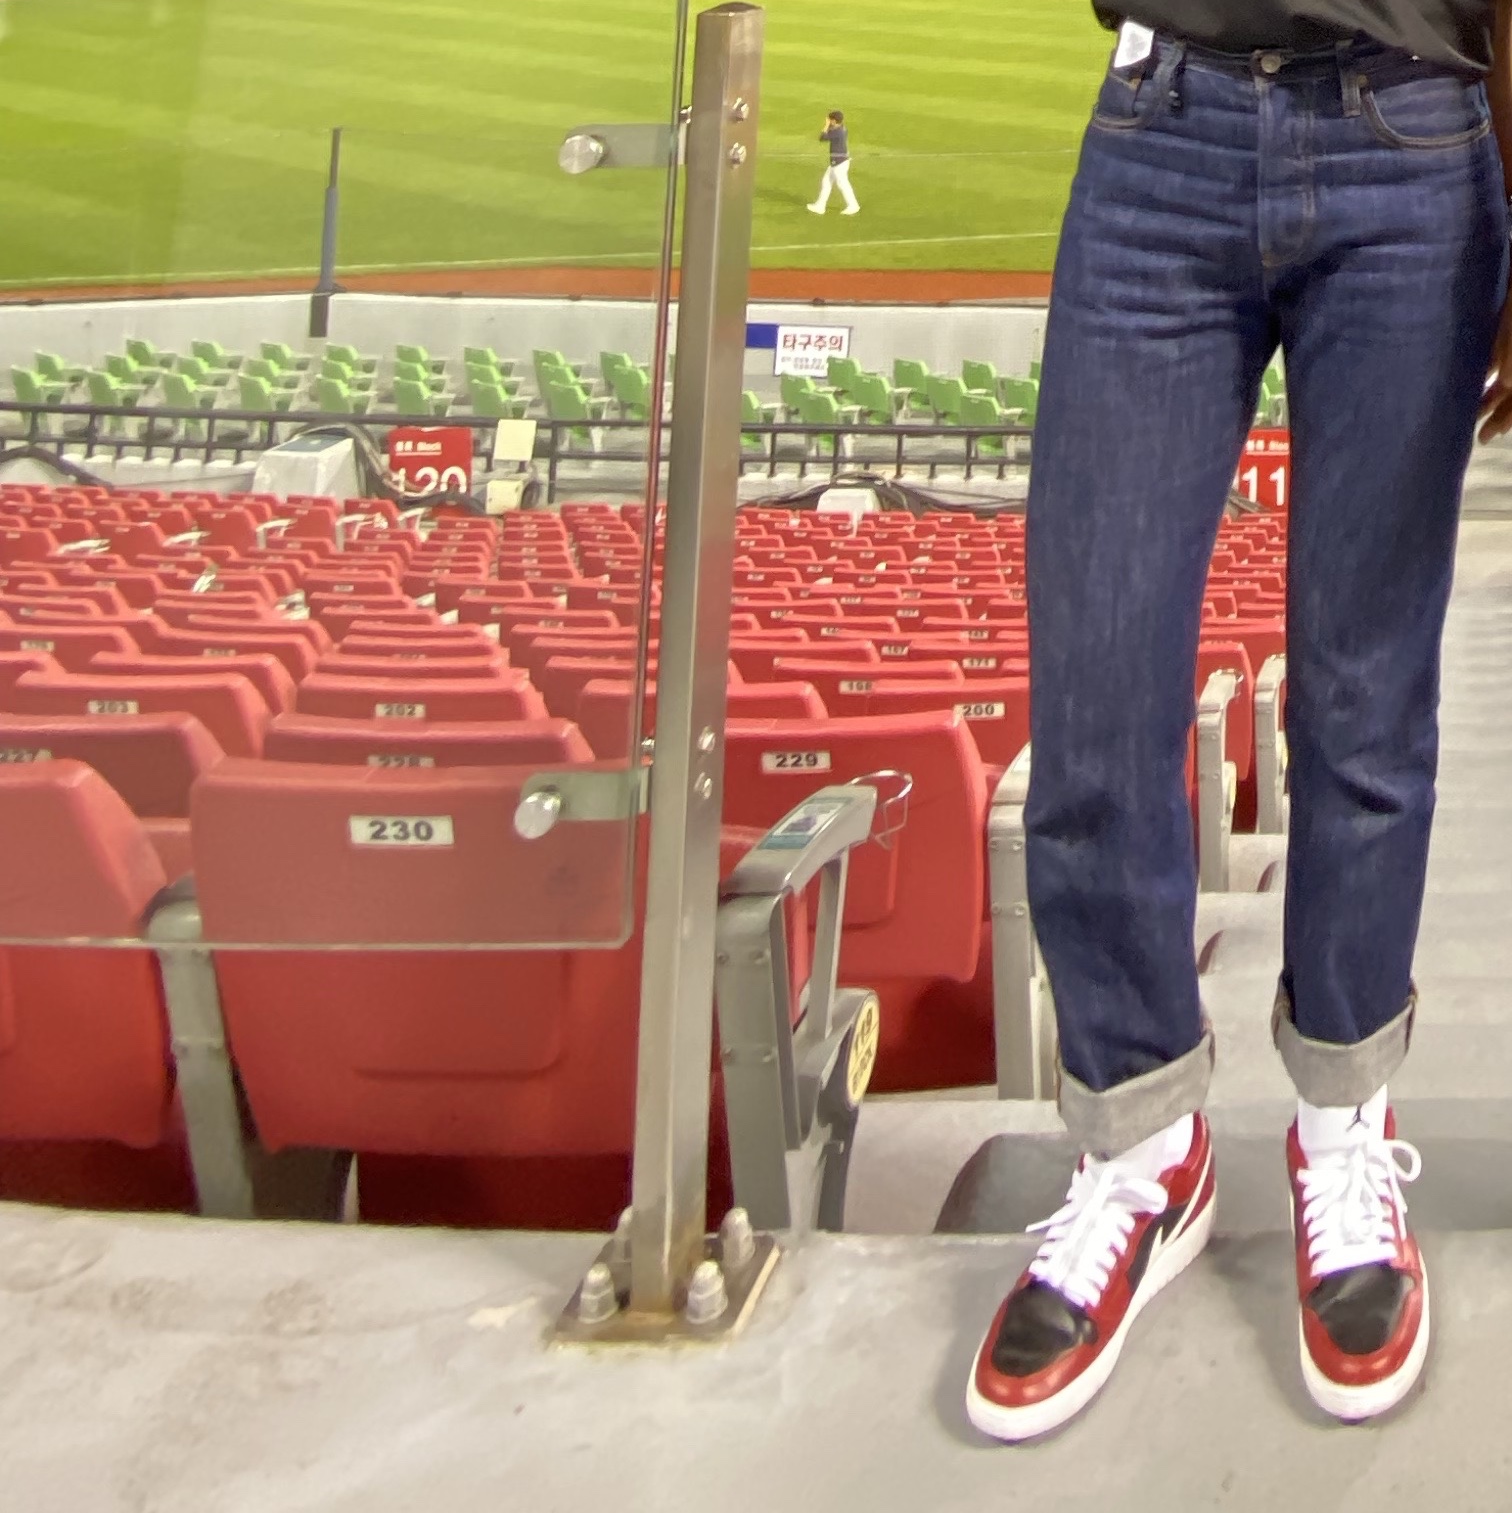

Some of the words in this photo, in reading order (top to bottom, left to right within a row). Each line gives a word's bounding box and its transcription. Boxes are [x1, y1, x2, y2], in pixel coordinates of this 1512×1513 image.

[781, 333, 844, 352] 타구주의
[383, 703, 417, 717] 202
[962, 704, 996, 717] 200
[774, 752, 819, 769] 229
[368, 819, 434, 842] 230
